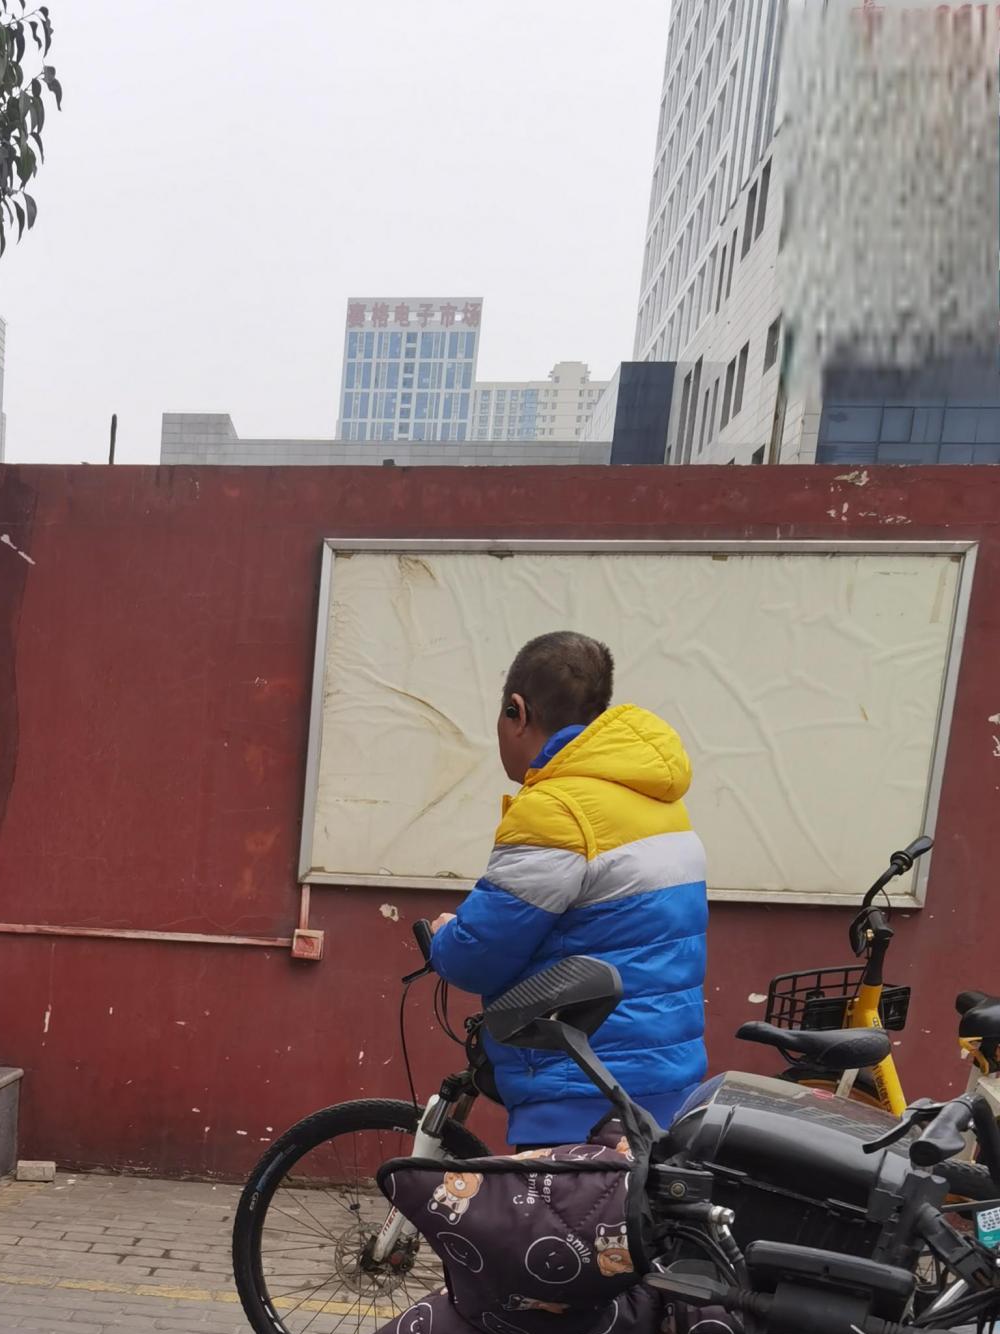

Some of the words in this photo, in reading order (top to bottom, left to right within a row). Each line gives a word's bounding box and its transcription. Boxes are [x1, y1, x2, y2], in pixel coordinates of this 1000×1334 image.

[347, 302, 481, 328] 赛格电子市场
[526, 1172, 539, 1205] smile
[565, 1233, 591, 1265] smile
